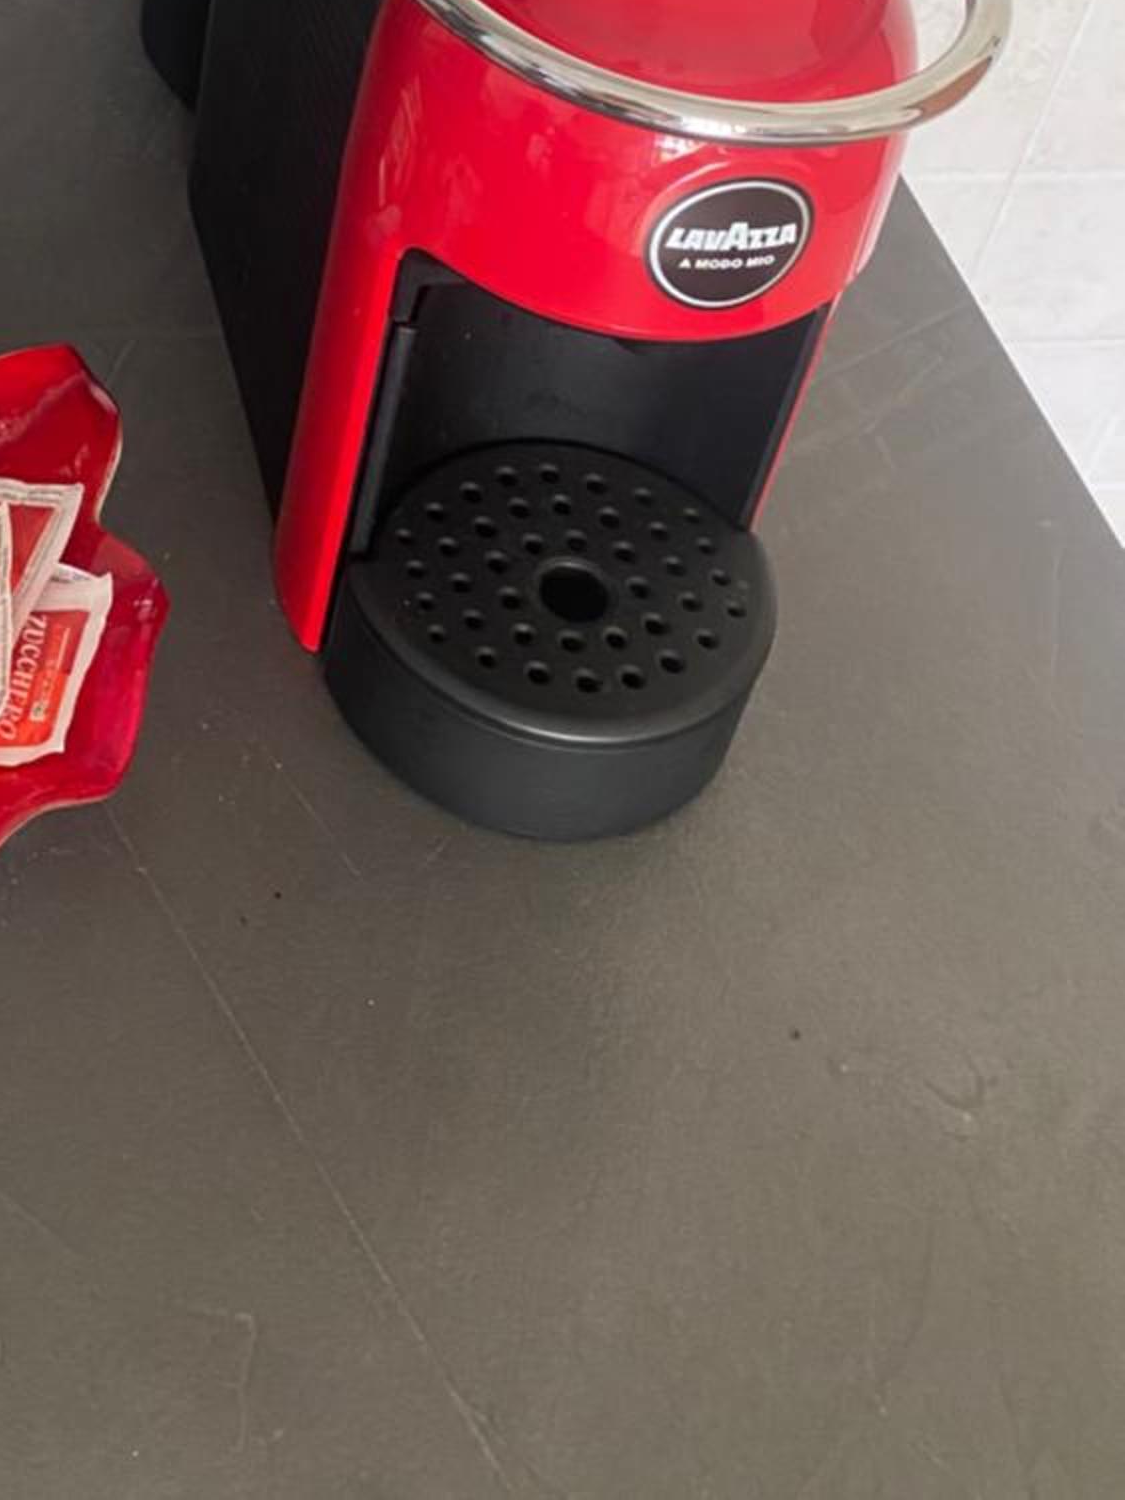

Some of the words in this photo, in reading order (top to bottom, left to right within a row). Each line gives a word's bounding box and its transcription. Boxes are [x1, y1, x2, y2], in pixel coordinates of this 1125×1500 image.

[665, 222, 797, 251] LAVAZZA
[679, 257, 691, 269] A
[695, 258, 742, 269] MODO
[746, 255, 775, 267] MIO
